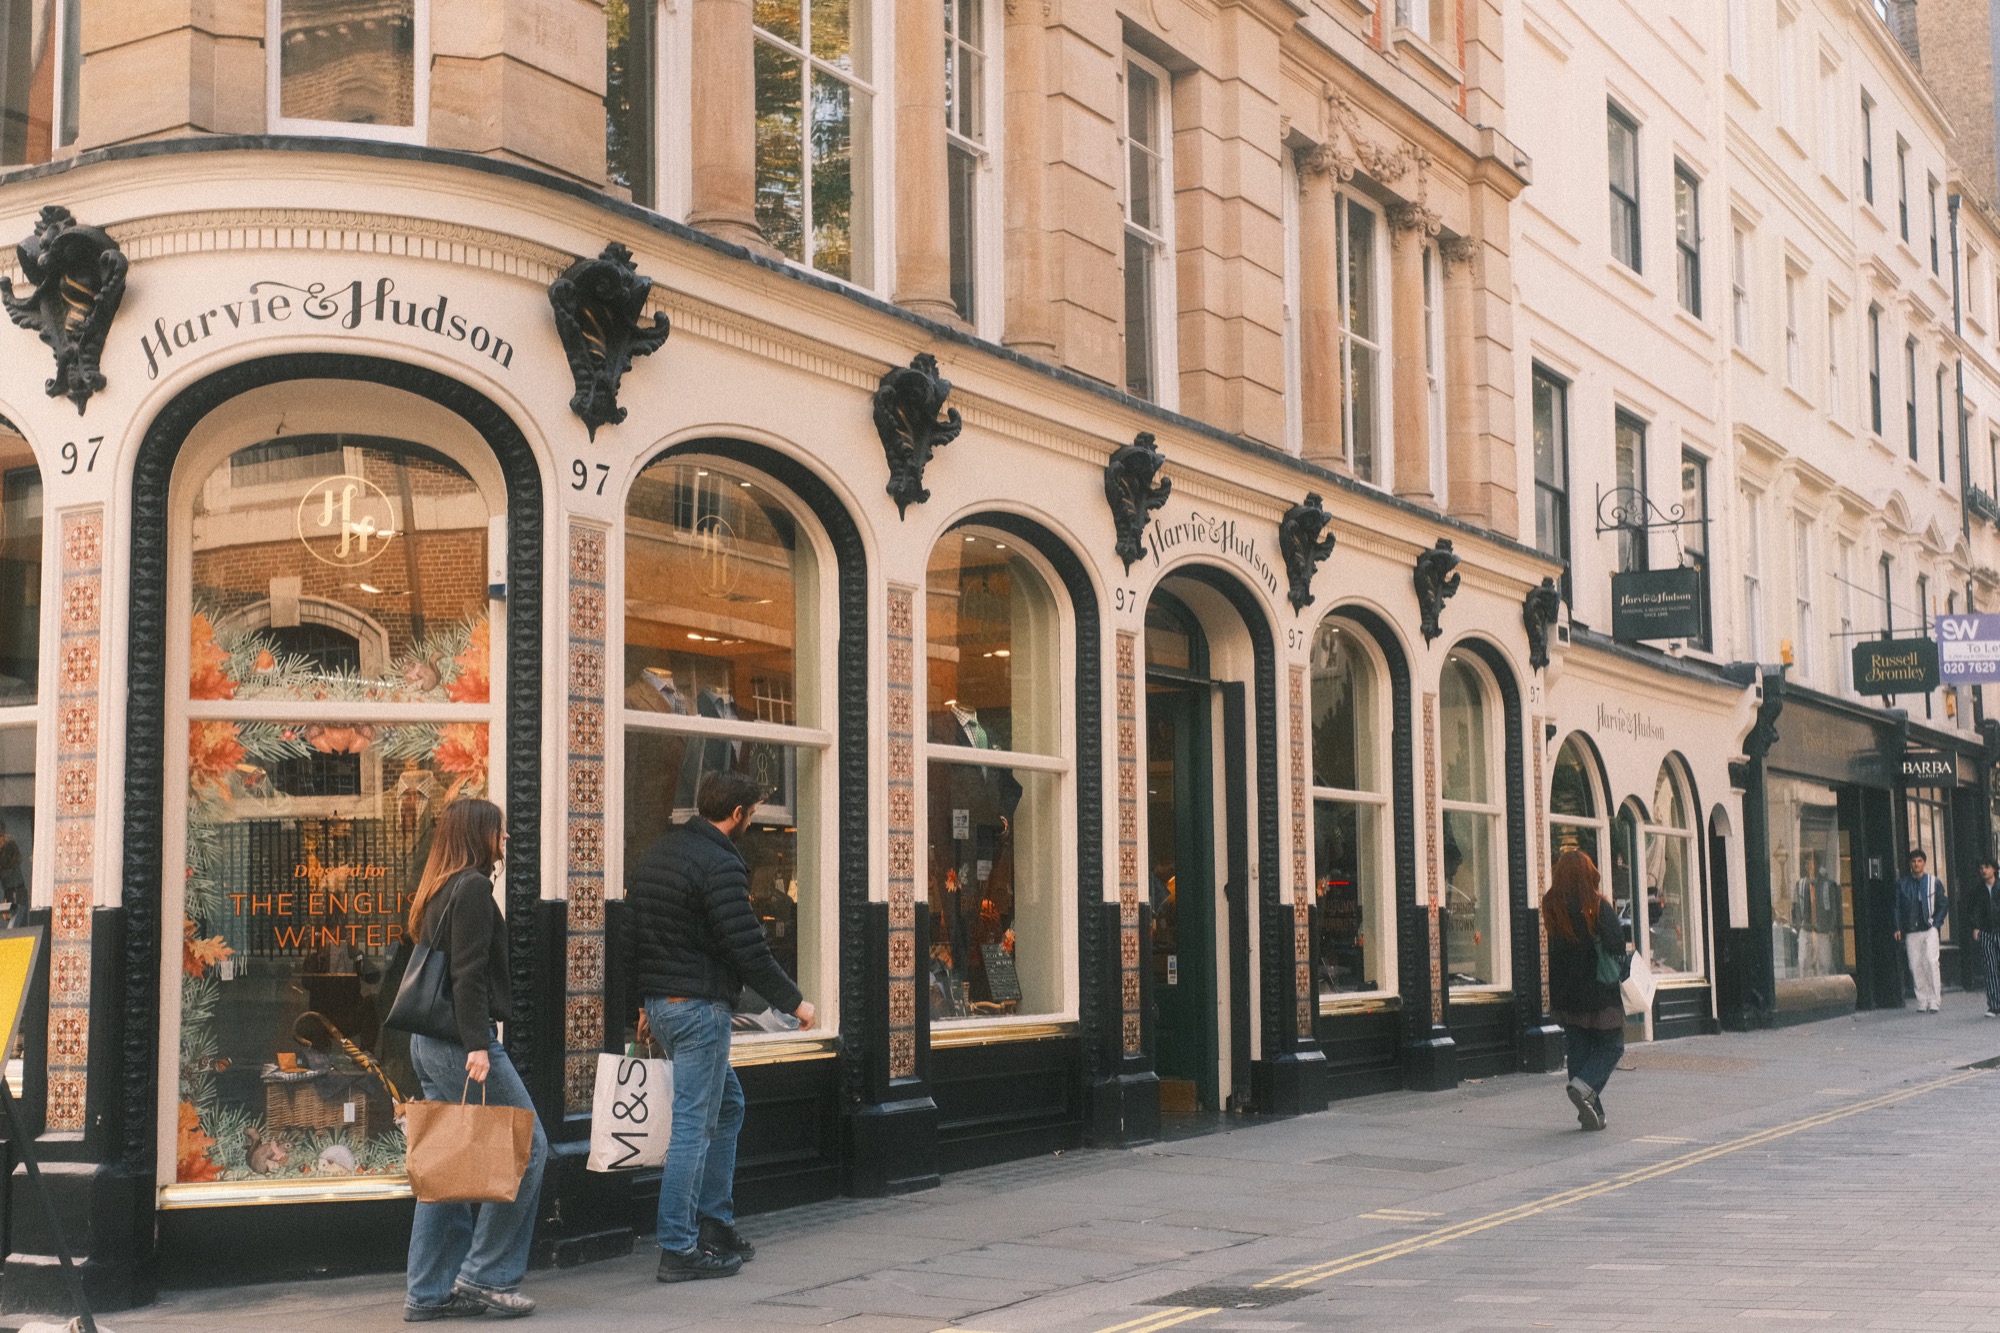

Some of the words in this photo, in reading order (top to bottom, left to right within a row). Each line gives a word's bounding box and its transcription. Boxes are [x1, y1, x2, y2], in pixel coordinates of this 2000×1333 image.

[139, 280, 293, 381] Harvie
[341, 277, 515, 371] Hudson
[60, 435, 105, 476] 97
[571, 458, 611, 497] 97
[1148, 511, 1206, 569] Harvie
[1219, 519, 1279, 595] Hudson
[1115, 586, 1137, 614] 97
[1620, 594, 1650, 606] Harvie
[1657, 591, 1691, 604] Hudson
[1287, 628, 1304, 650] 97
[1941, 619, 1979, 640] SW
[1871, 651, 1918, 669] Russell
[1967, 644, 1981, 654] To
[1943, 662, 1965, 675] 020
[1968, 661, 1997, 674] 7629
[1530, 686, 1541, 705] 97
[1597, 702, 1626, 733] Harvie
[1632, 712, 1665, 741] Hudson
[1903, 761, 1952, 775] BARBA
[294, 864, 361, 879] Dressed
[363, 864, 388, 881] for
[229, 892, 294, 916] THE
[273, 924, 404, 949] WINTER
[607, 1058, 649, 1170] M&S
